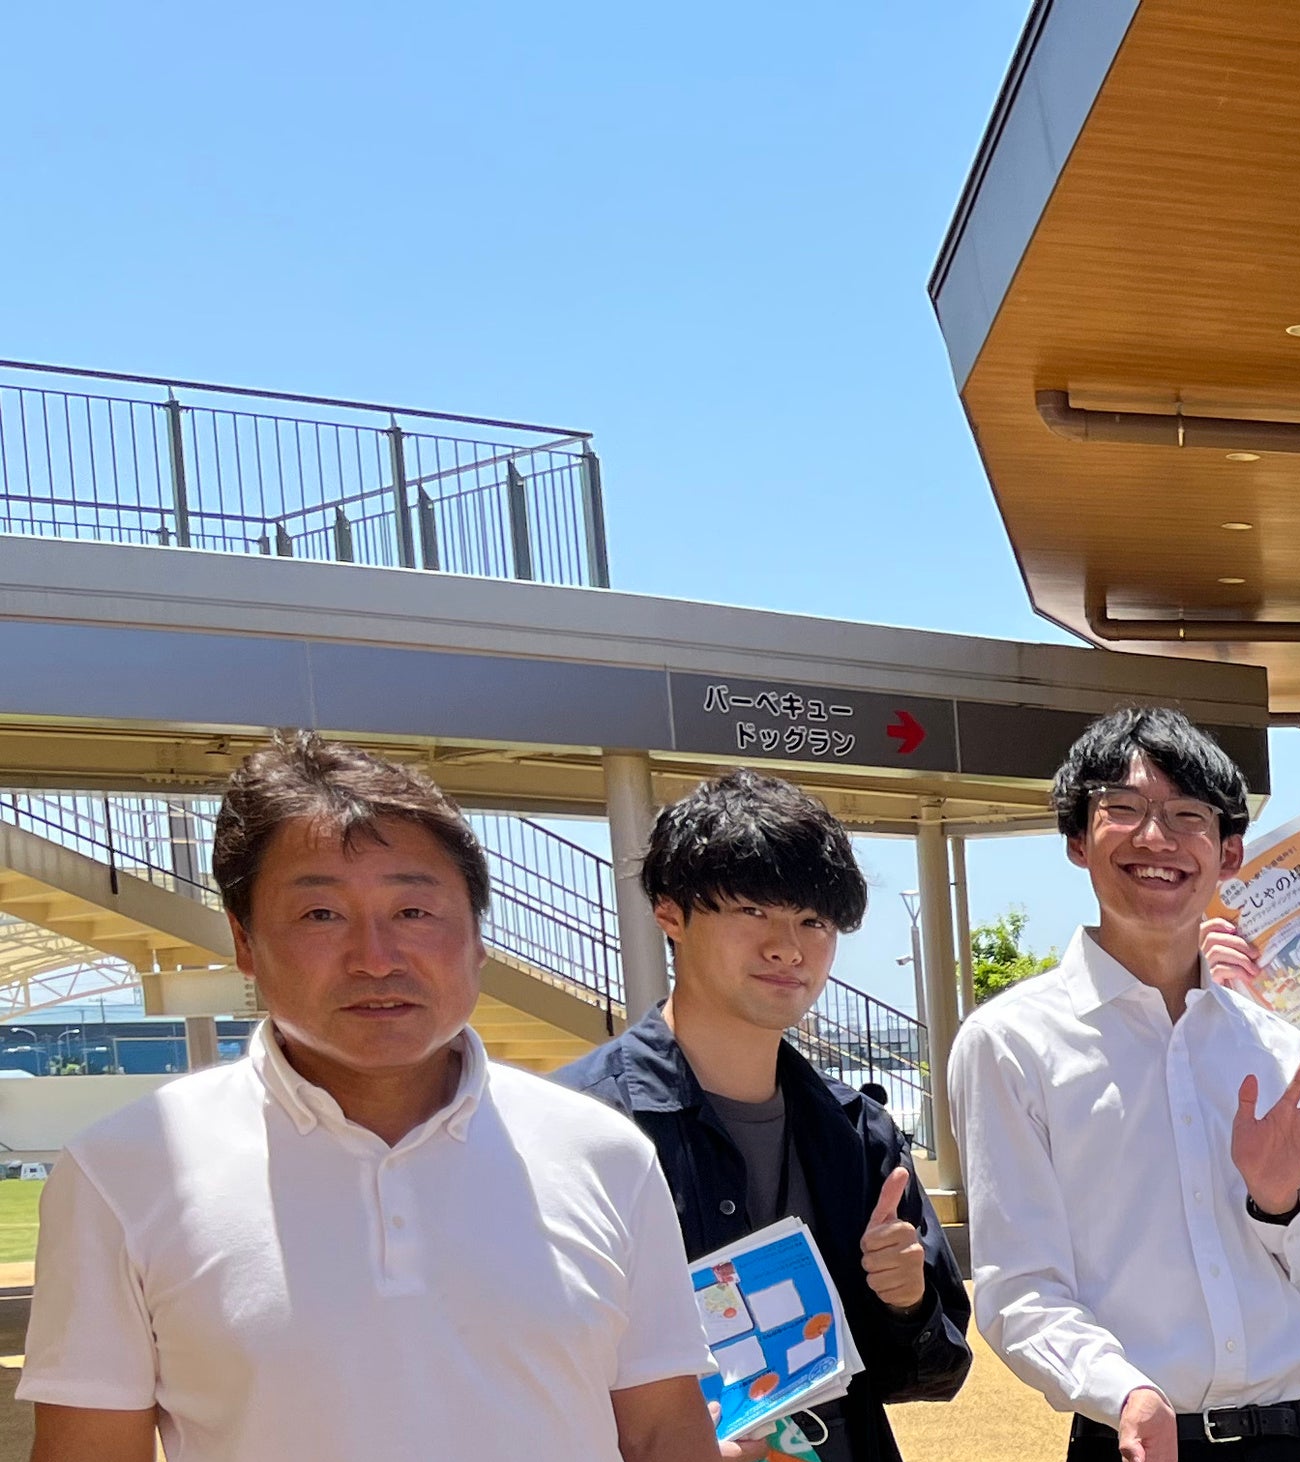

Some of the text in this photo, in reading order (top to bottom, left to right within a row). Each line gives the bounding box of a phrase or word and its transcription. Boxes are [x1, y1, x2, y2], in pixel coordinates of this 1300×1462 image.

[703, 684, 854, 722] バーベキュー
[736, 721, 855, 756] ドッグラン
